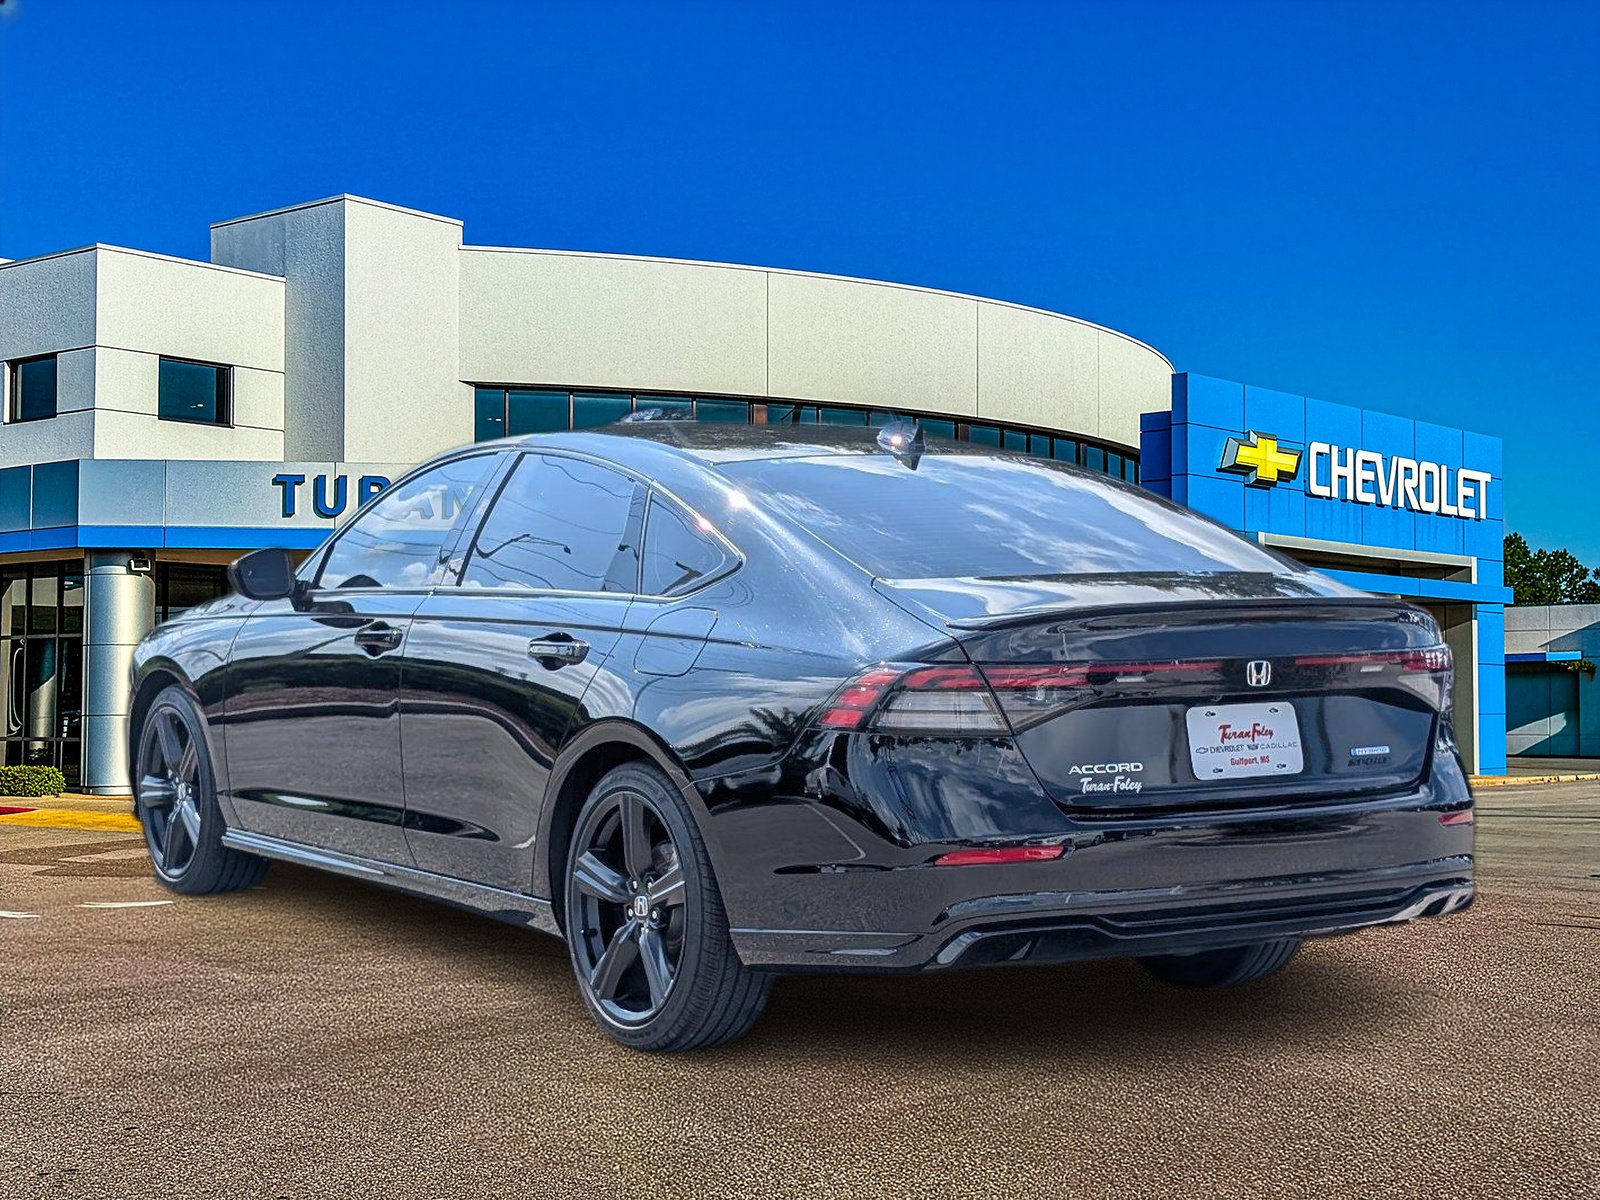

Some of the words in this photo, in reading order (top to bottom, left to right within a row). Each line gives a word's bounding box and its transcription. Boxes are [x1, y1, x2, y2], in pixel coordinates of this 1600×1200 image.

[1308, 441, 1492, 520] CHEVROLET
[1259, 741, 1298, 750] CADILLAC
[1260, 755, 1270, 763] MS
[1068, 762, 1144, 775] ACCORD
